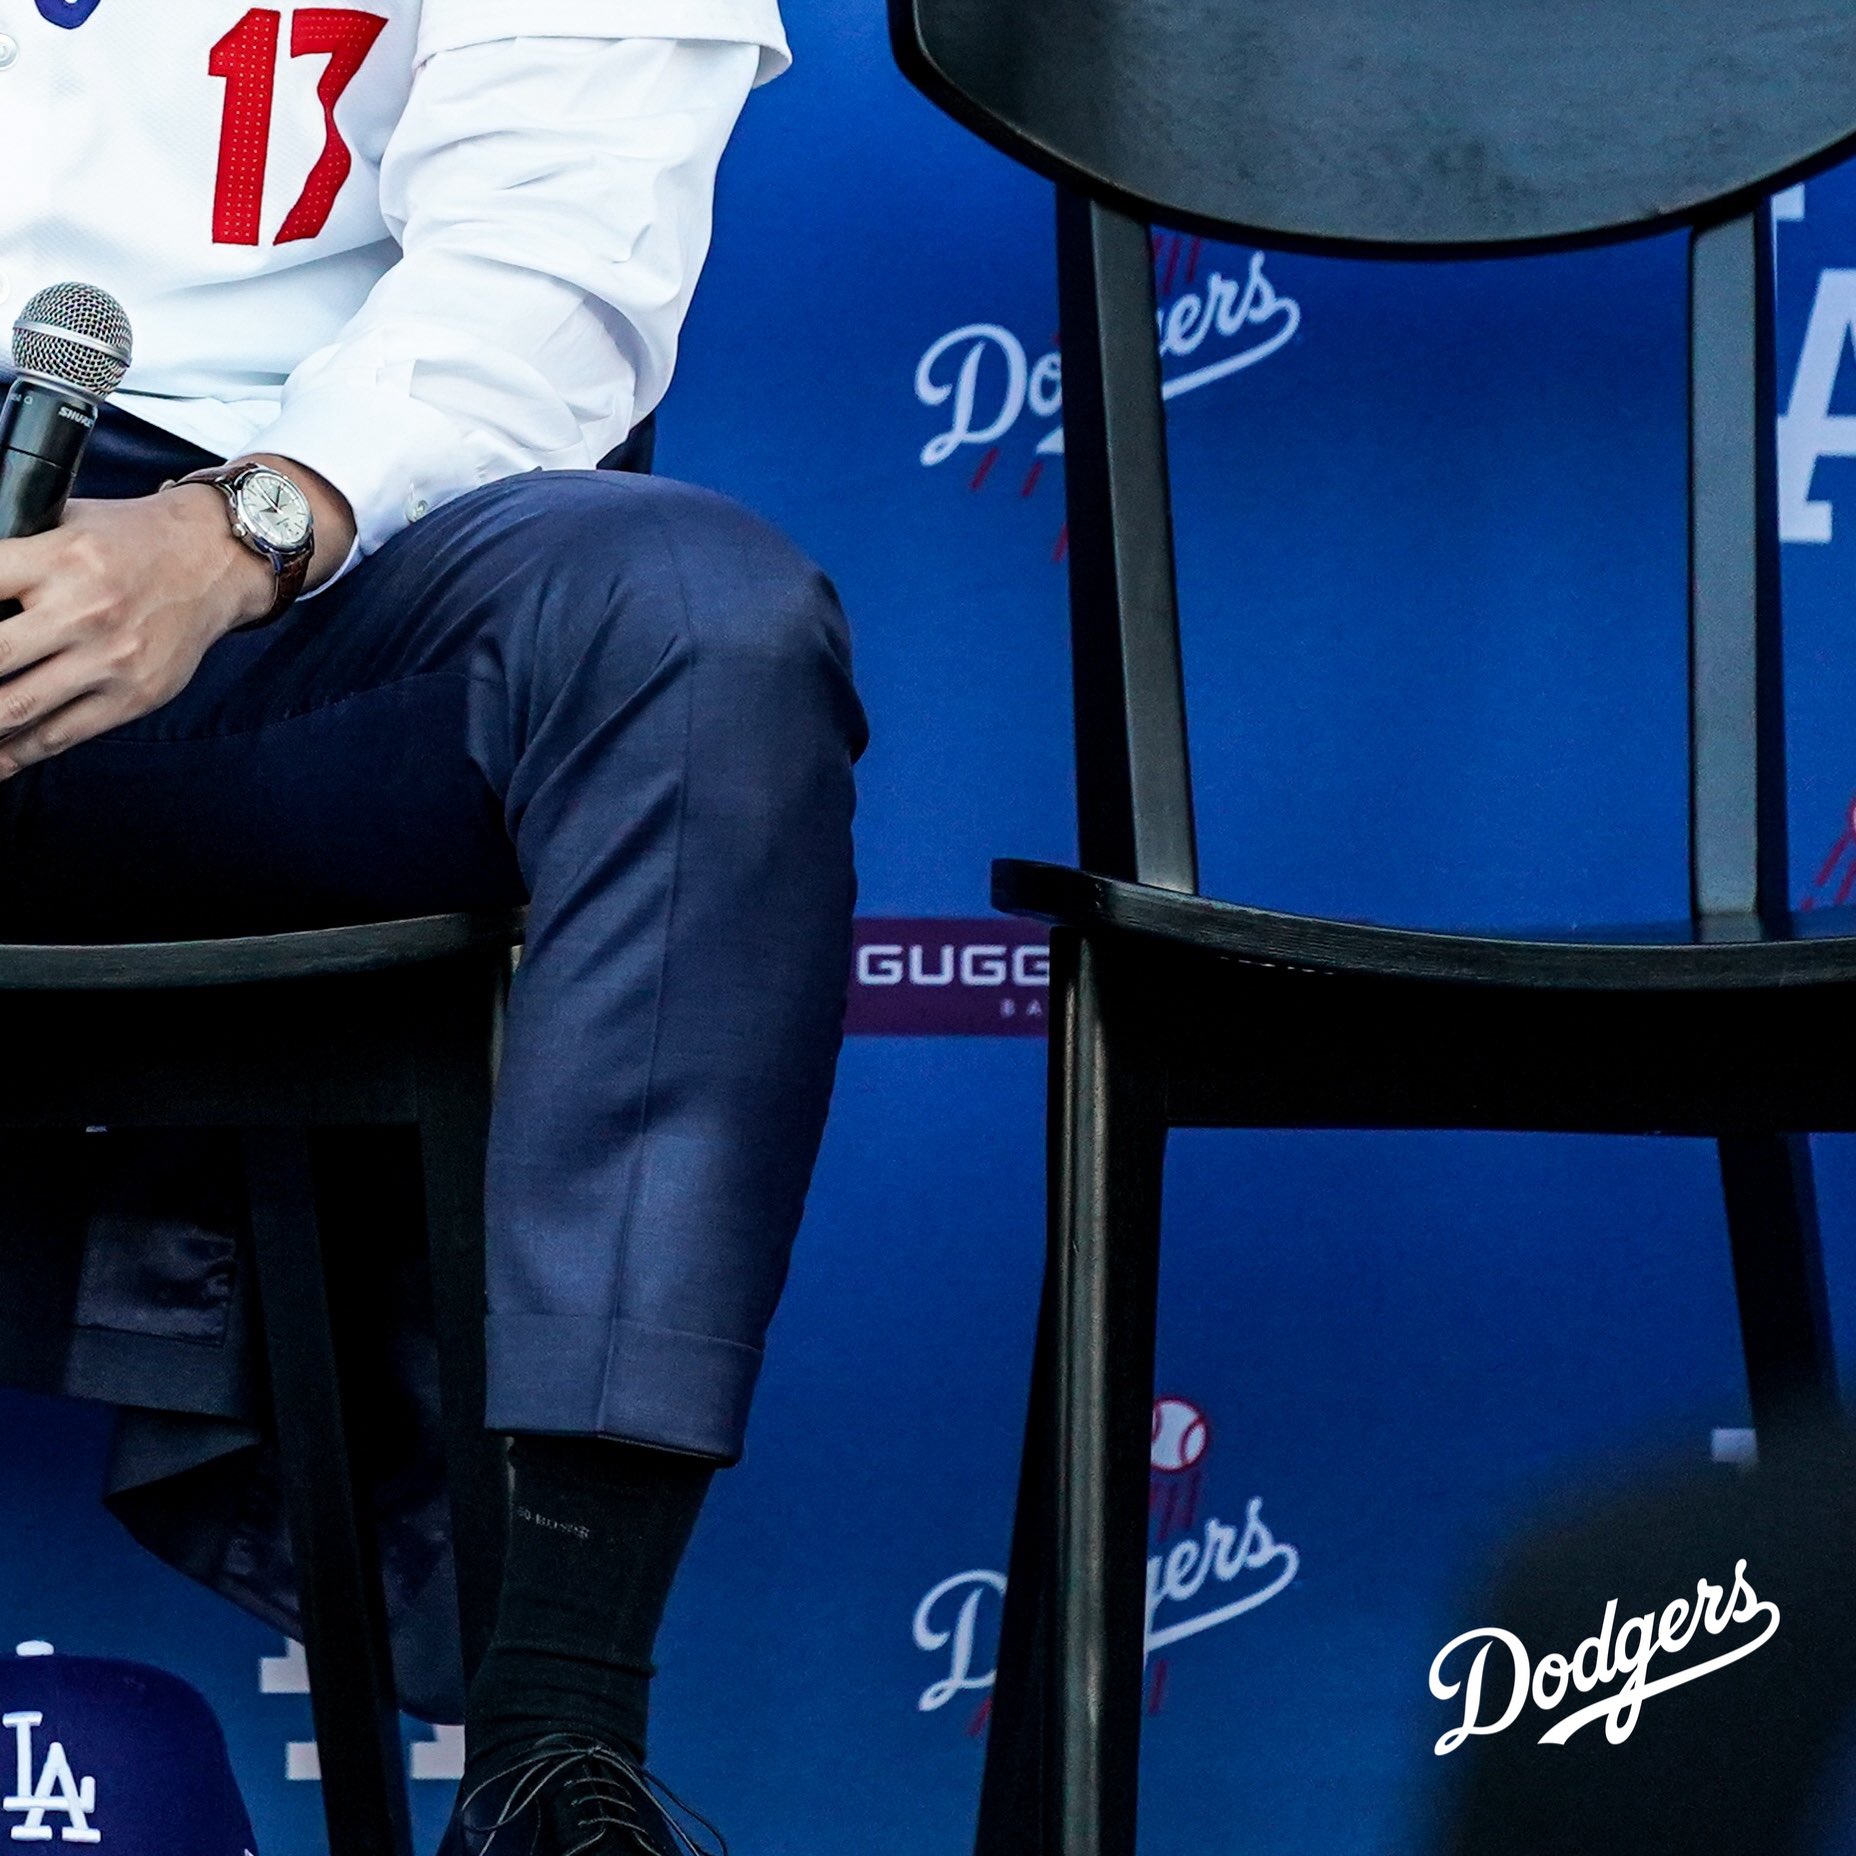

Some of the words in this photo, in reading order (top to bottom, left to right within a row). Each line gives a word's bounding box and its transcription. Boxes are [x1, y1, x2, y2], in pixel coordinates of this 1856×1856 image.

[207, 7, 389, 247] 17
[914, 250, 1301, 467] Doers
[2, 1710, 102, 1844] LA
